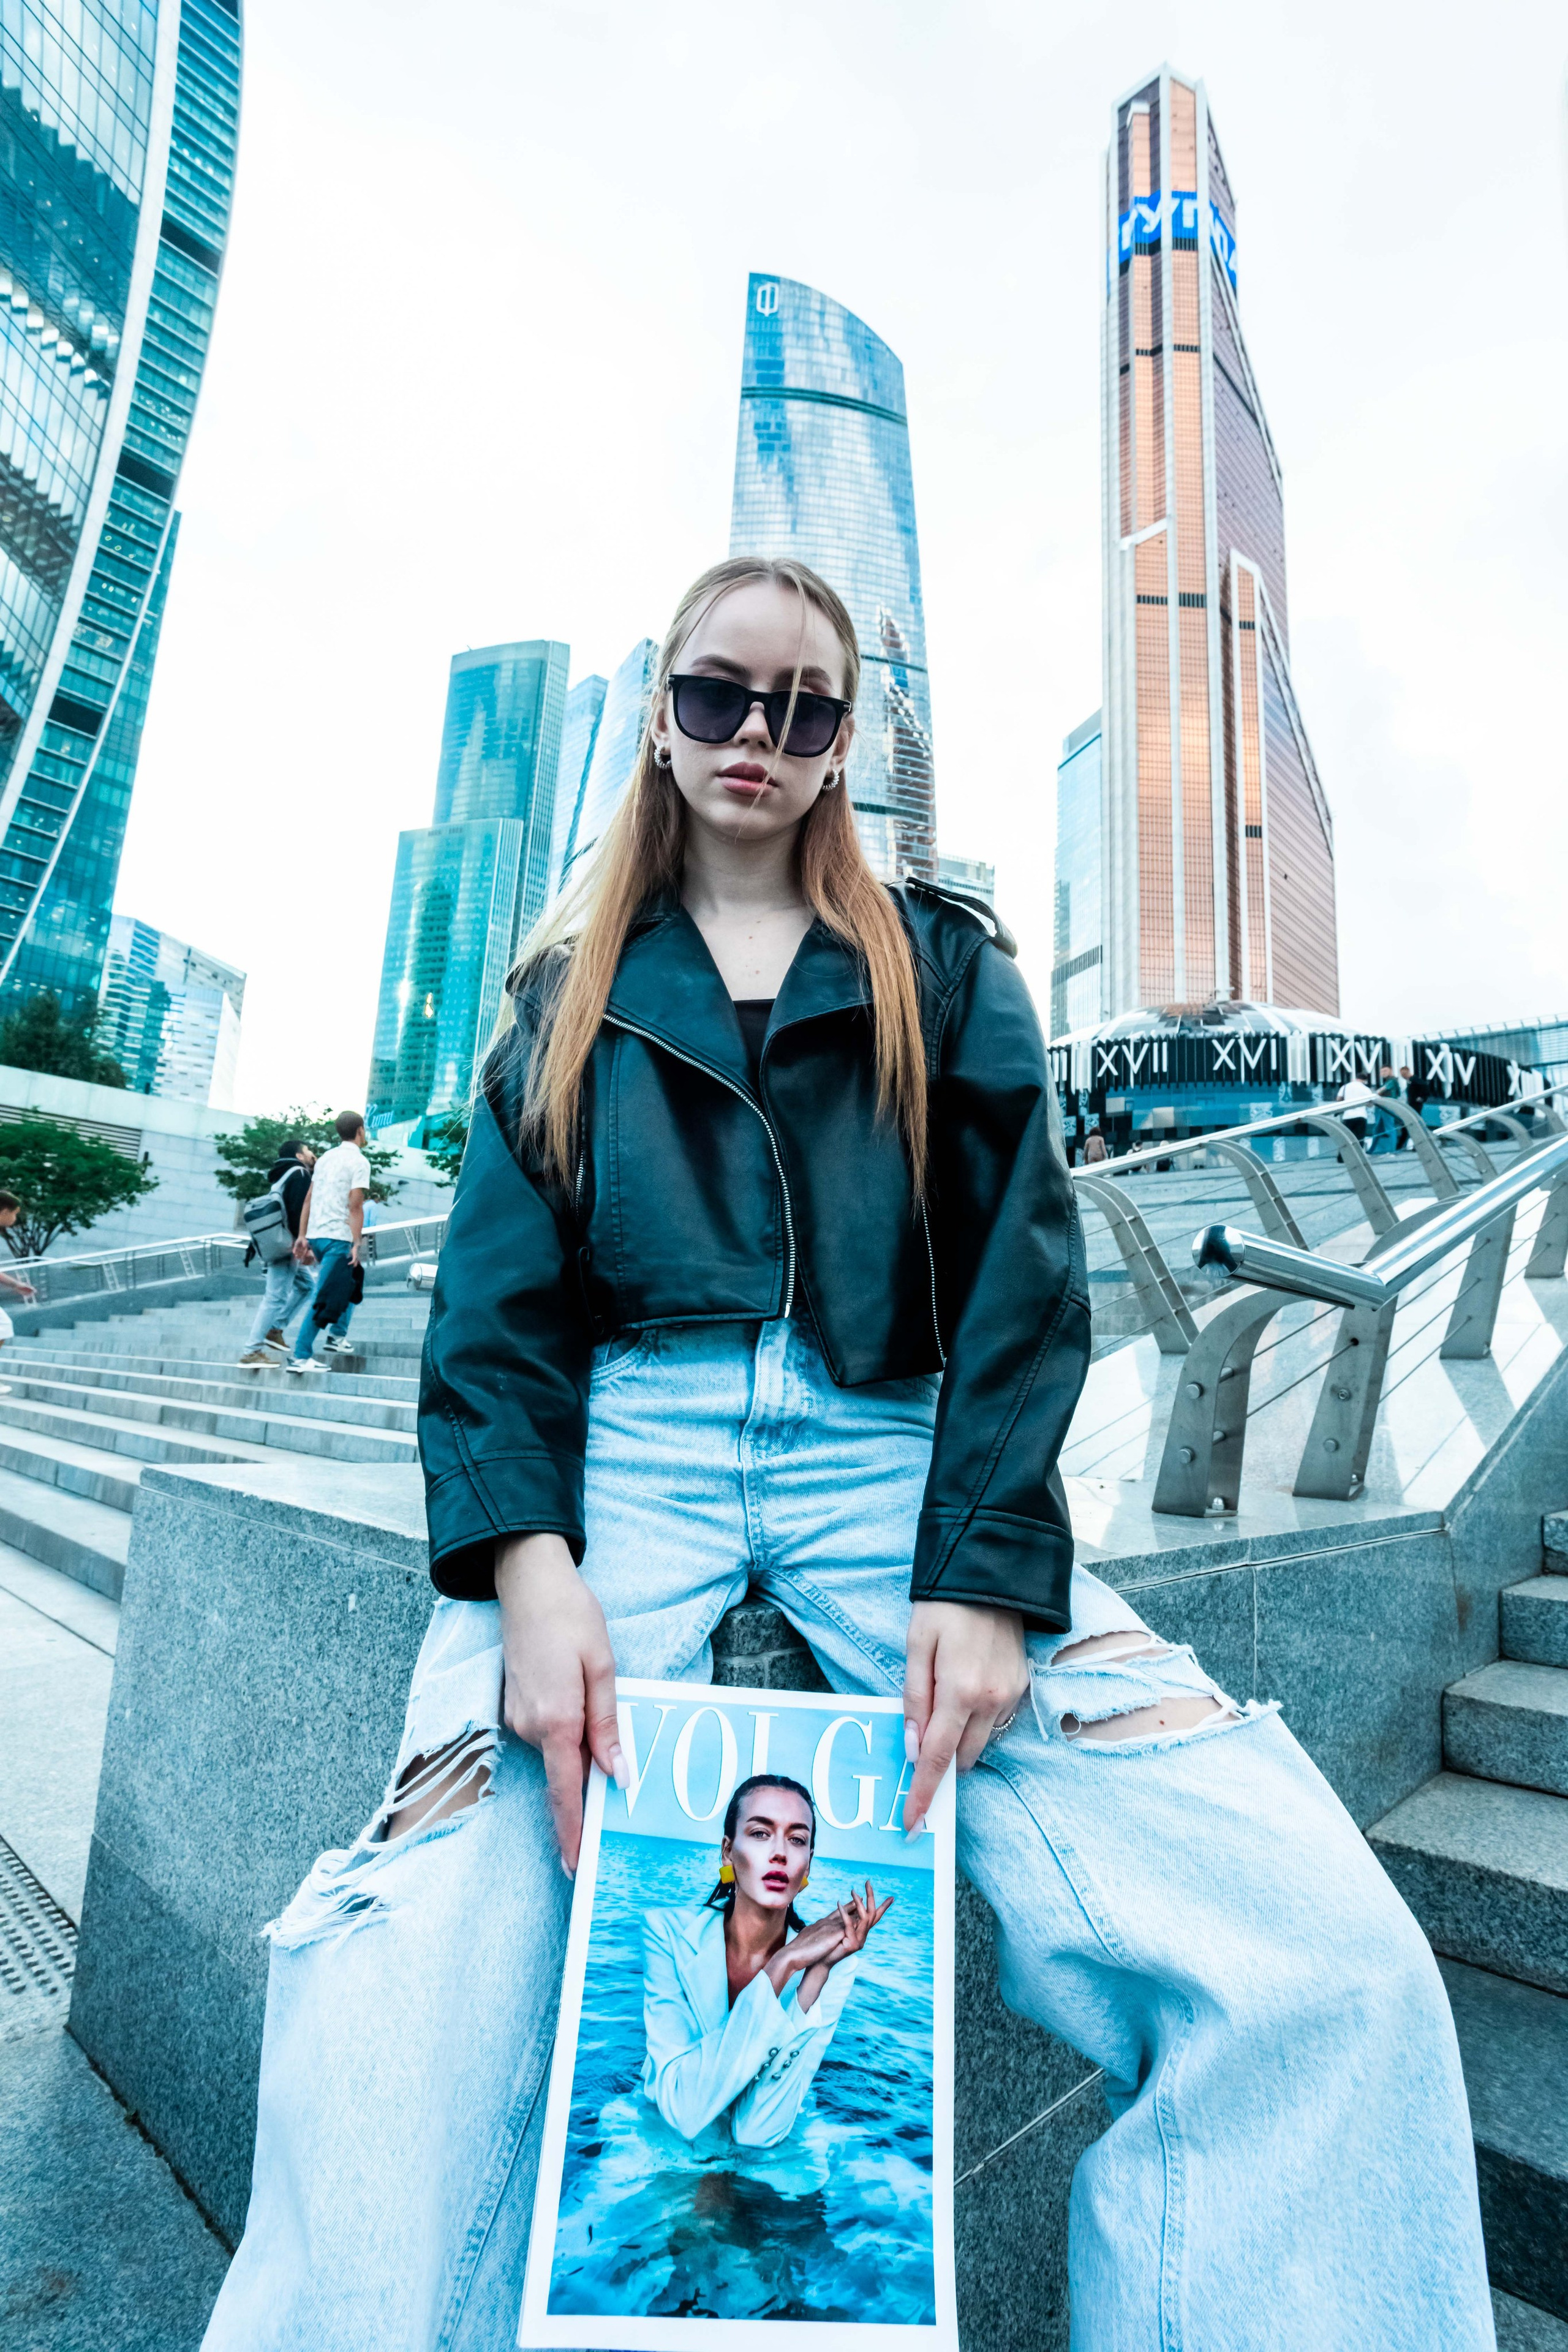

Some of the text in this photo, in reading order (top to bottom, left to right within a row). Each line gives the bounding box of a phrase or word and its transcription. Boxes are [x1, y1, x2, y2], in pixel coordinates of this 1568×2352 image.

[1097, 1041, 1167, 1077] XVII
[1212, 1038, 1277, 1071] XVI
[1331, 1039, 1382, 1074] XV
[1425, 1048, 1476, 1085] XIV
